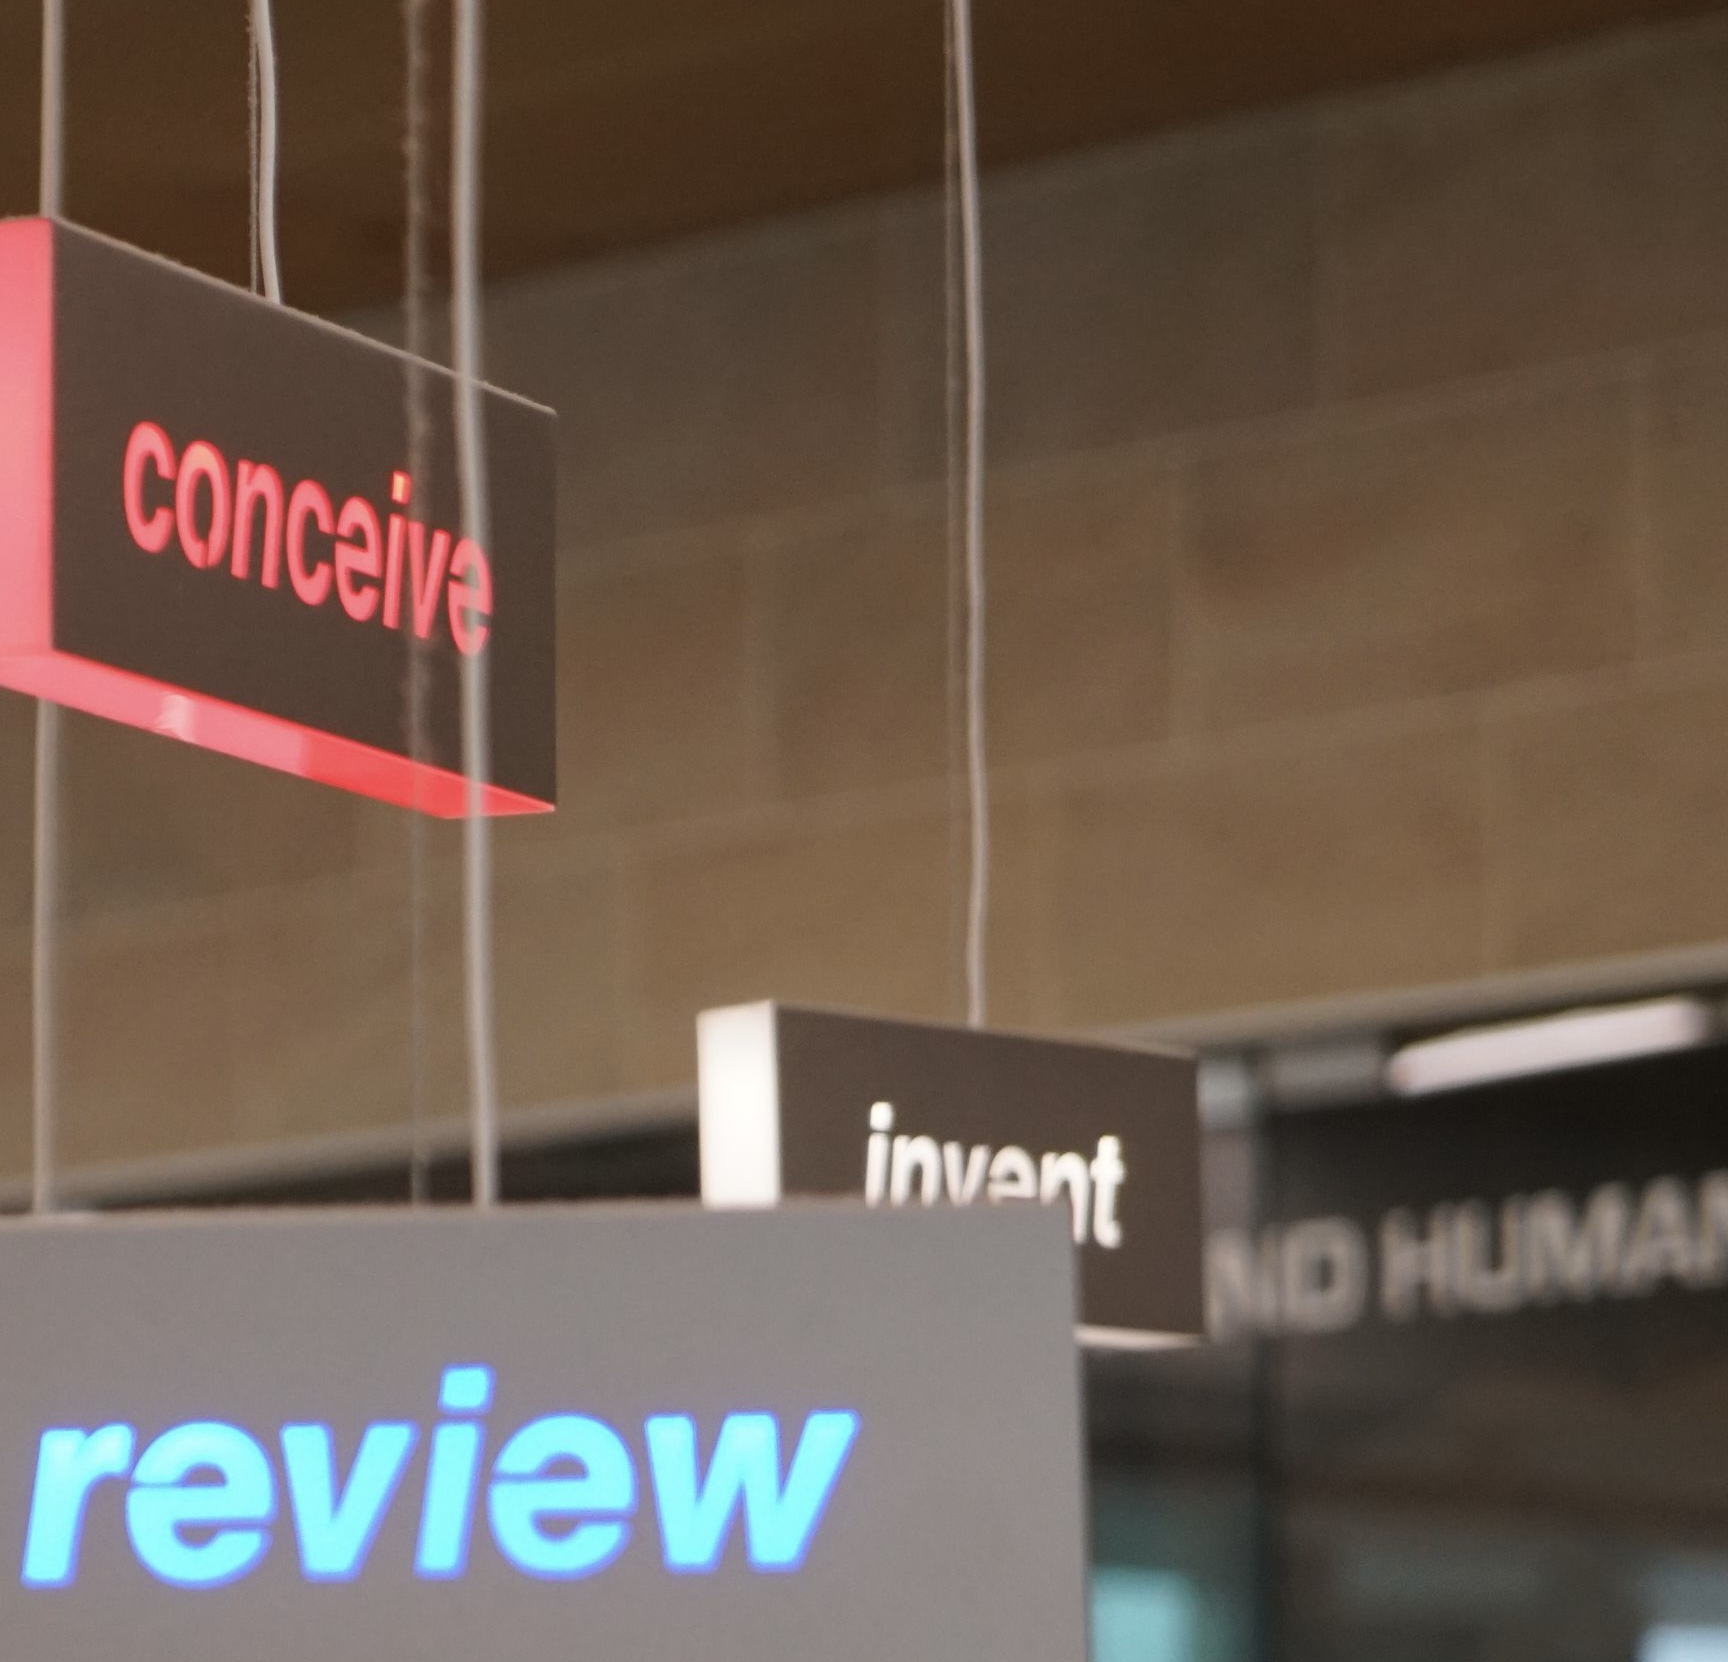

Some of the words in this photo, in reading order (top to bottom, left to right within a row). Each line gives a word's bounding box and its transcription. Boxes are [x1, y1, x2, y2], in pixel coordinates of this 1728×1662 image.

[123, 420, 493, 657] conceive
[1204, 1216, 1368, 1344] ND
[22, 1364, 860, 1589] review
